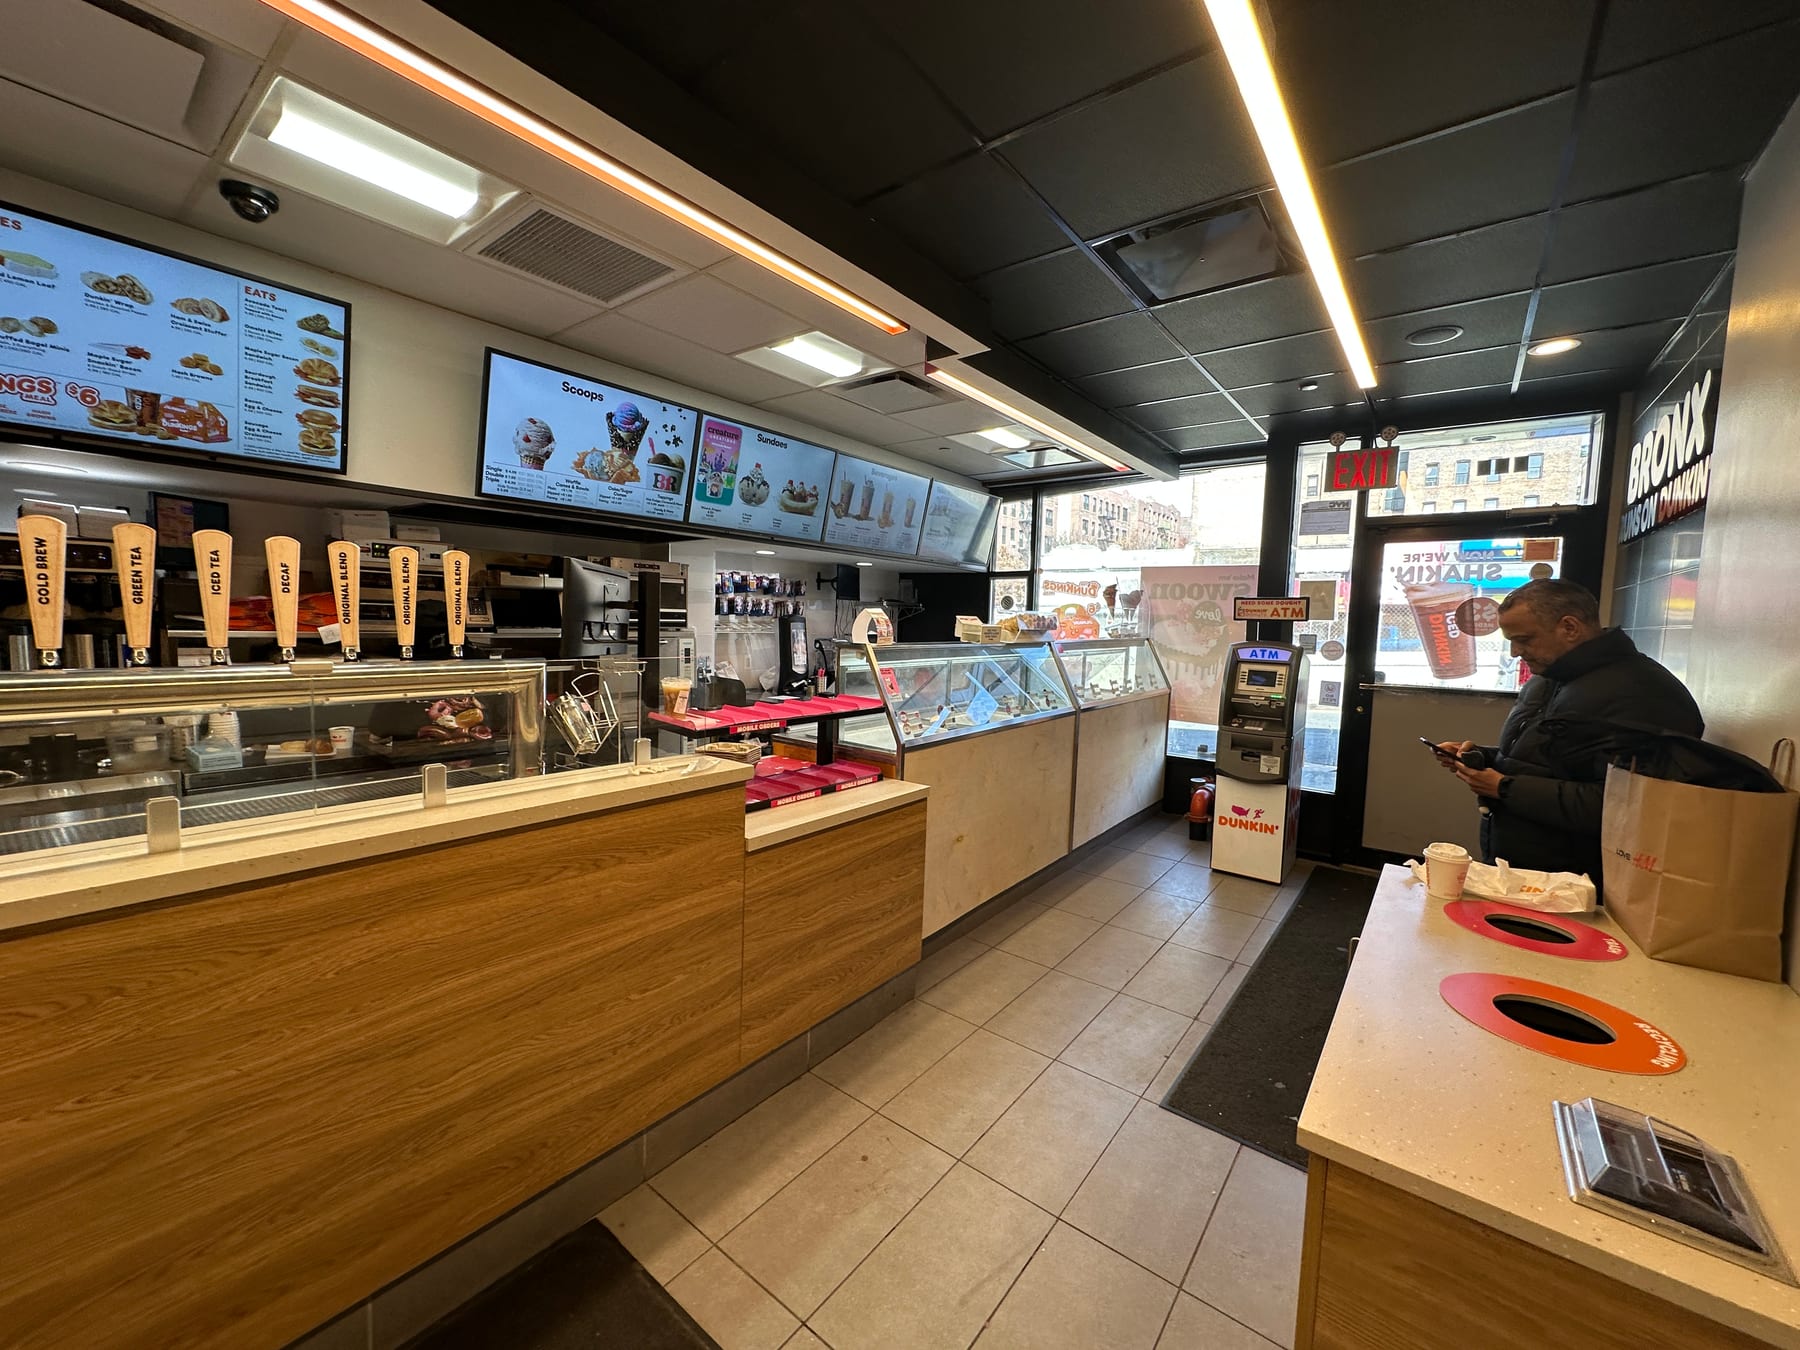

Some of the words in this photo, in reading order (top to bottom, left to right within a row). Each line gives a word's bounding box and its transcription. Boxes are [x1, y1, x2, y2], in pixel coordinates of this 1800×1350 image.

[244, 286, 277, 302] EATS
[24, 394, 52, 403] MEAL
[68, 384, 98, 406] $6
[561, 380, 605, 402] Scoops
[708, 426, 740, 441] creature
[757, 433, 788, 450] Sundaes
[1627, 369, 1712, 505] BRONX
[485, 464, 503, 473] Single
[485, 471, 505, 479] Double
[485, 476, 500, 484] Triple
[1333, 449, 1393, 490] EXIT
[1640, 493, 1659, 533] ON
[35, 537, 49, 571] BREW
[131, 546, 142, 570] TEA
[209, 549, 220, 569] TEA
[339, 551, 348, 580] BLEND
[281, 562, 291, 594] DECAF
[402, 556, 410, 582] BLEND
[454, 560, 462, 585] BLEND
[37, 575, 51, 605] COLD
[132, 573, 144, 605] GREEN
[210, 571, 222, 595] ICED
[341, 582, 351, 625] ORIGINAL
[403, 585, 412, 625] ORIGINAL
[454, 587, 463, 625] ORIGINAL
[1270, 607, 1304, 618] ATM
[1249, 649, 1279, 660] ATM
[737, 724, 758, 733] MOBILE
[759, 721, 780, 730] ORDERS
[777, 796, 796, 806] MOBILE
[797, 791, 816, 801] ORDERS
[1218, 815, 1279, 835] DUNKIN'
[1633, 1021, 1680, 1069] RECYCLING
